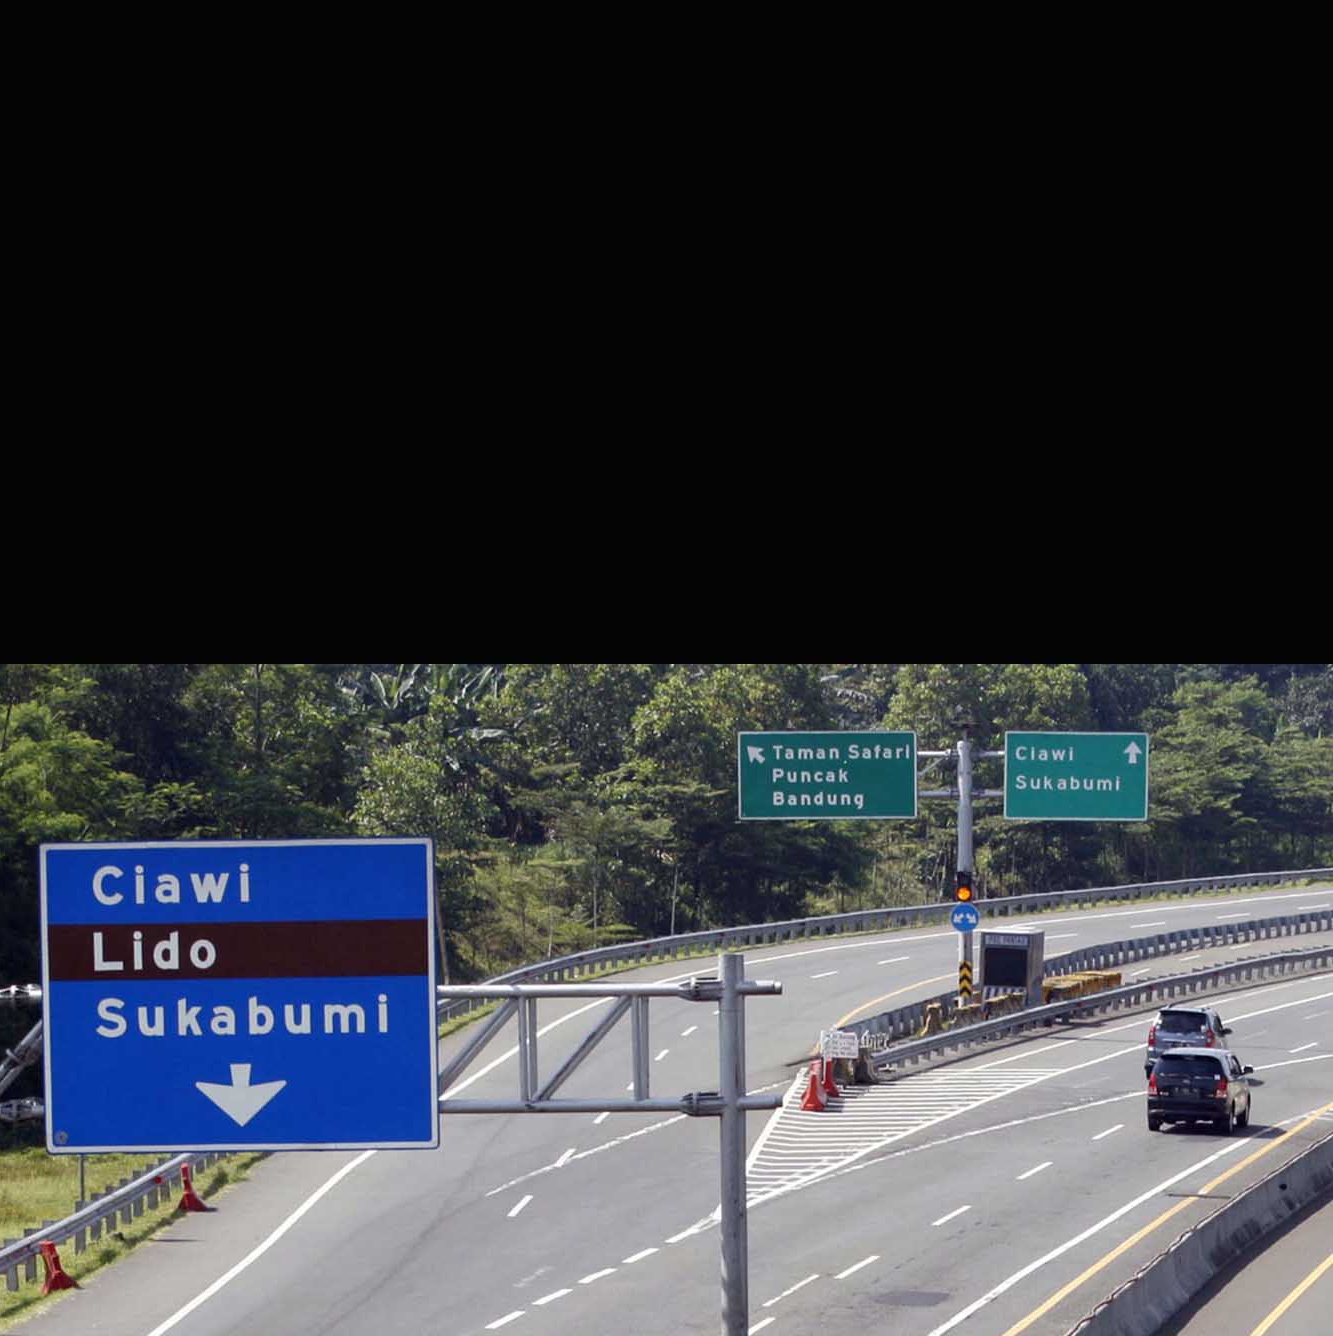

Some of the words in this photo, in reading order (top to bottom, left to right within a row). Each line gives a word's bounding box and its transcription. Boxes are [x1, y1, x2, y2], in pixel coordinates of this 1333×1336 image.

[773, 745, 840, 759] Taman
[848, 744, 910, 759] Safari
[1015, 746, 1074, 761] Ciawi
[772, 768, 849, 783] Puncak
[1015, 775, 1121, 791] Sukabumi
[773, 791, 864, 809] Bandung
[92, 863, 250, 905] Ciawi
[93, 931, 216, 971] Lido
[97, 994, 389, 1038] Sukabumi
